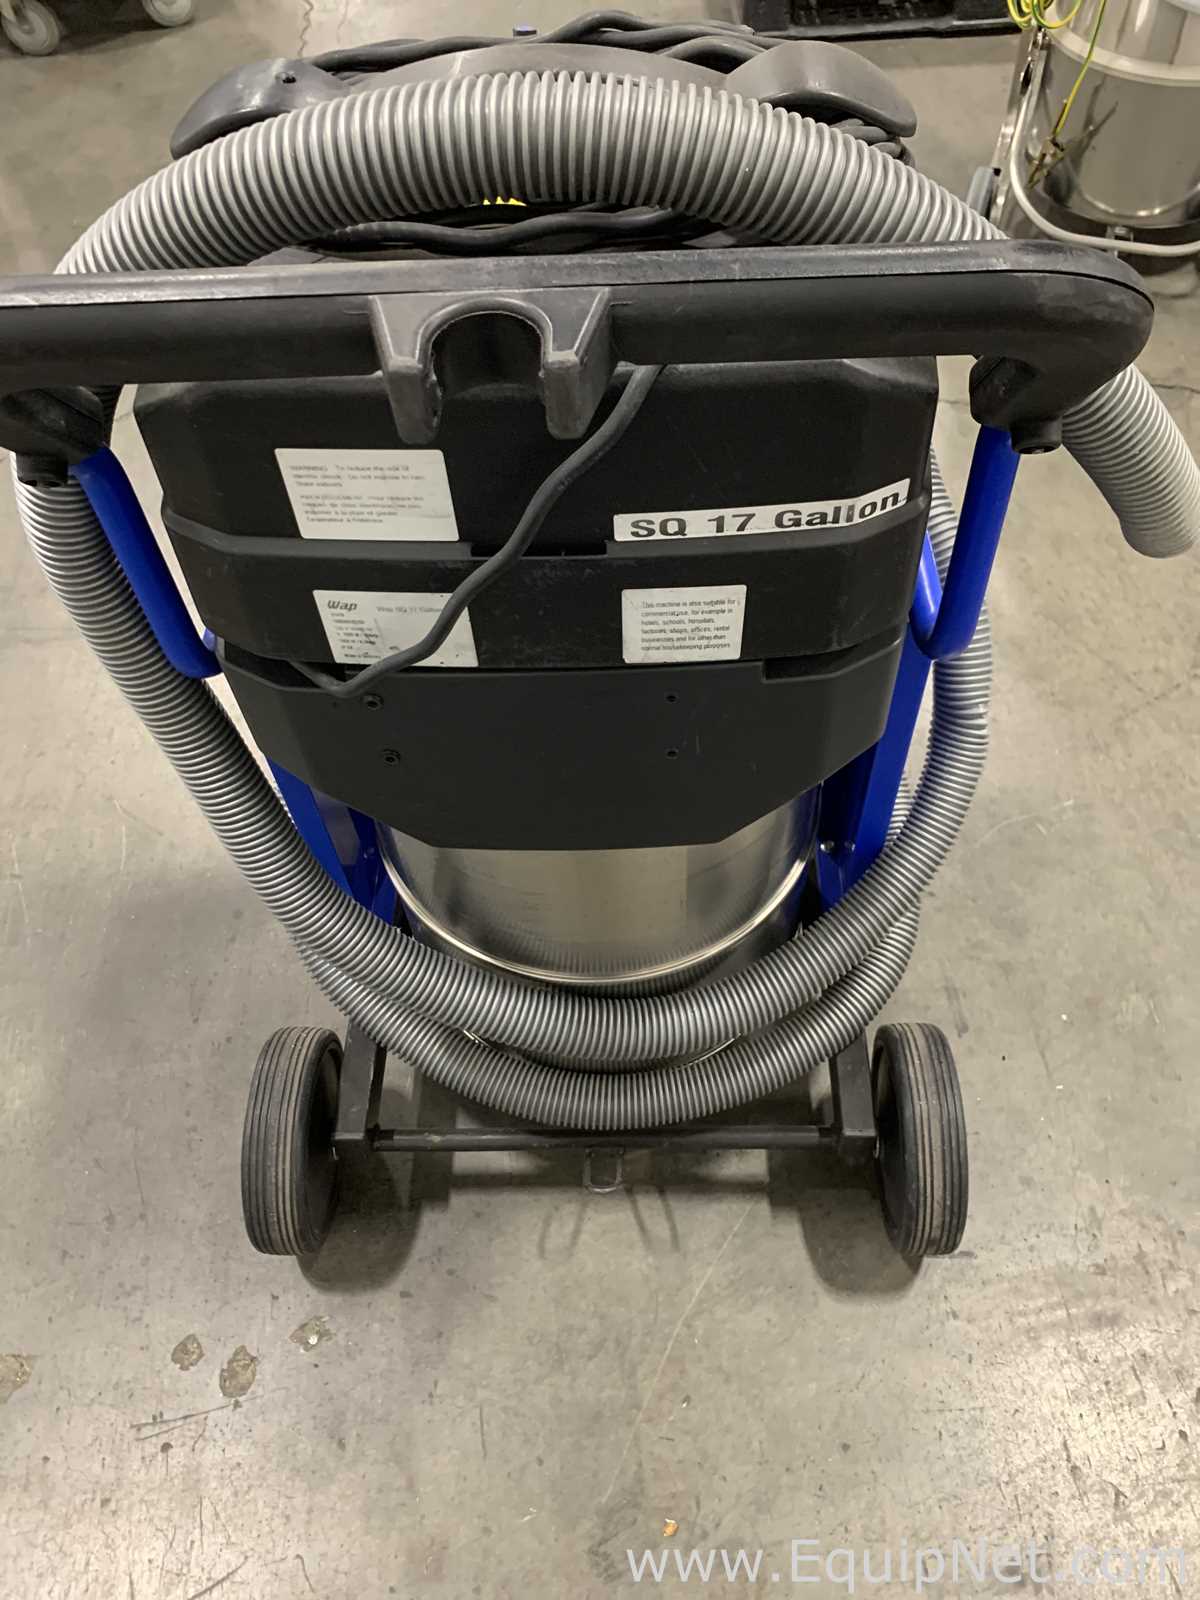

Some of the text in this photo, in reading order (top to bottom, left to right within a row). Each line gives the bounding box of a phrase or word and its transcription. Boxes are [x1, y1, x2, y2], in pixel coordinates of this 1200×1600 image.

[630, 492, 900, 538] SQ 17 Gallon
[327, 600, 358, 612] Wap
